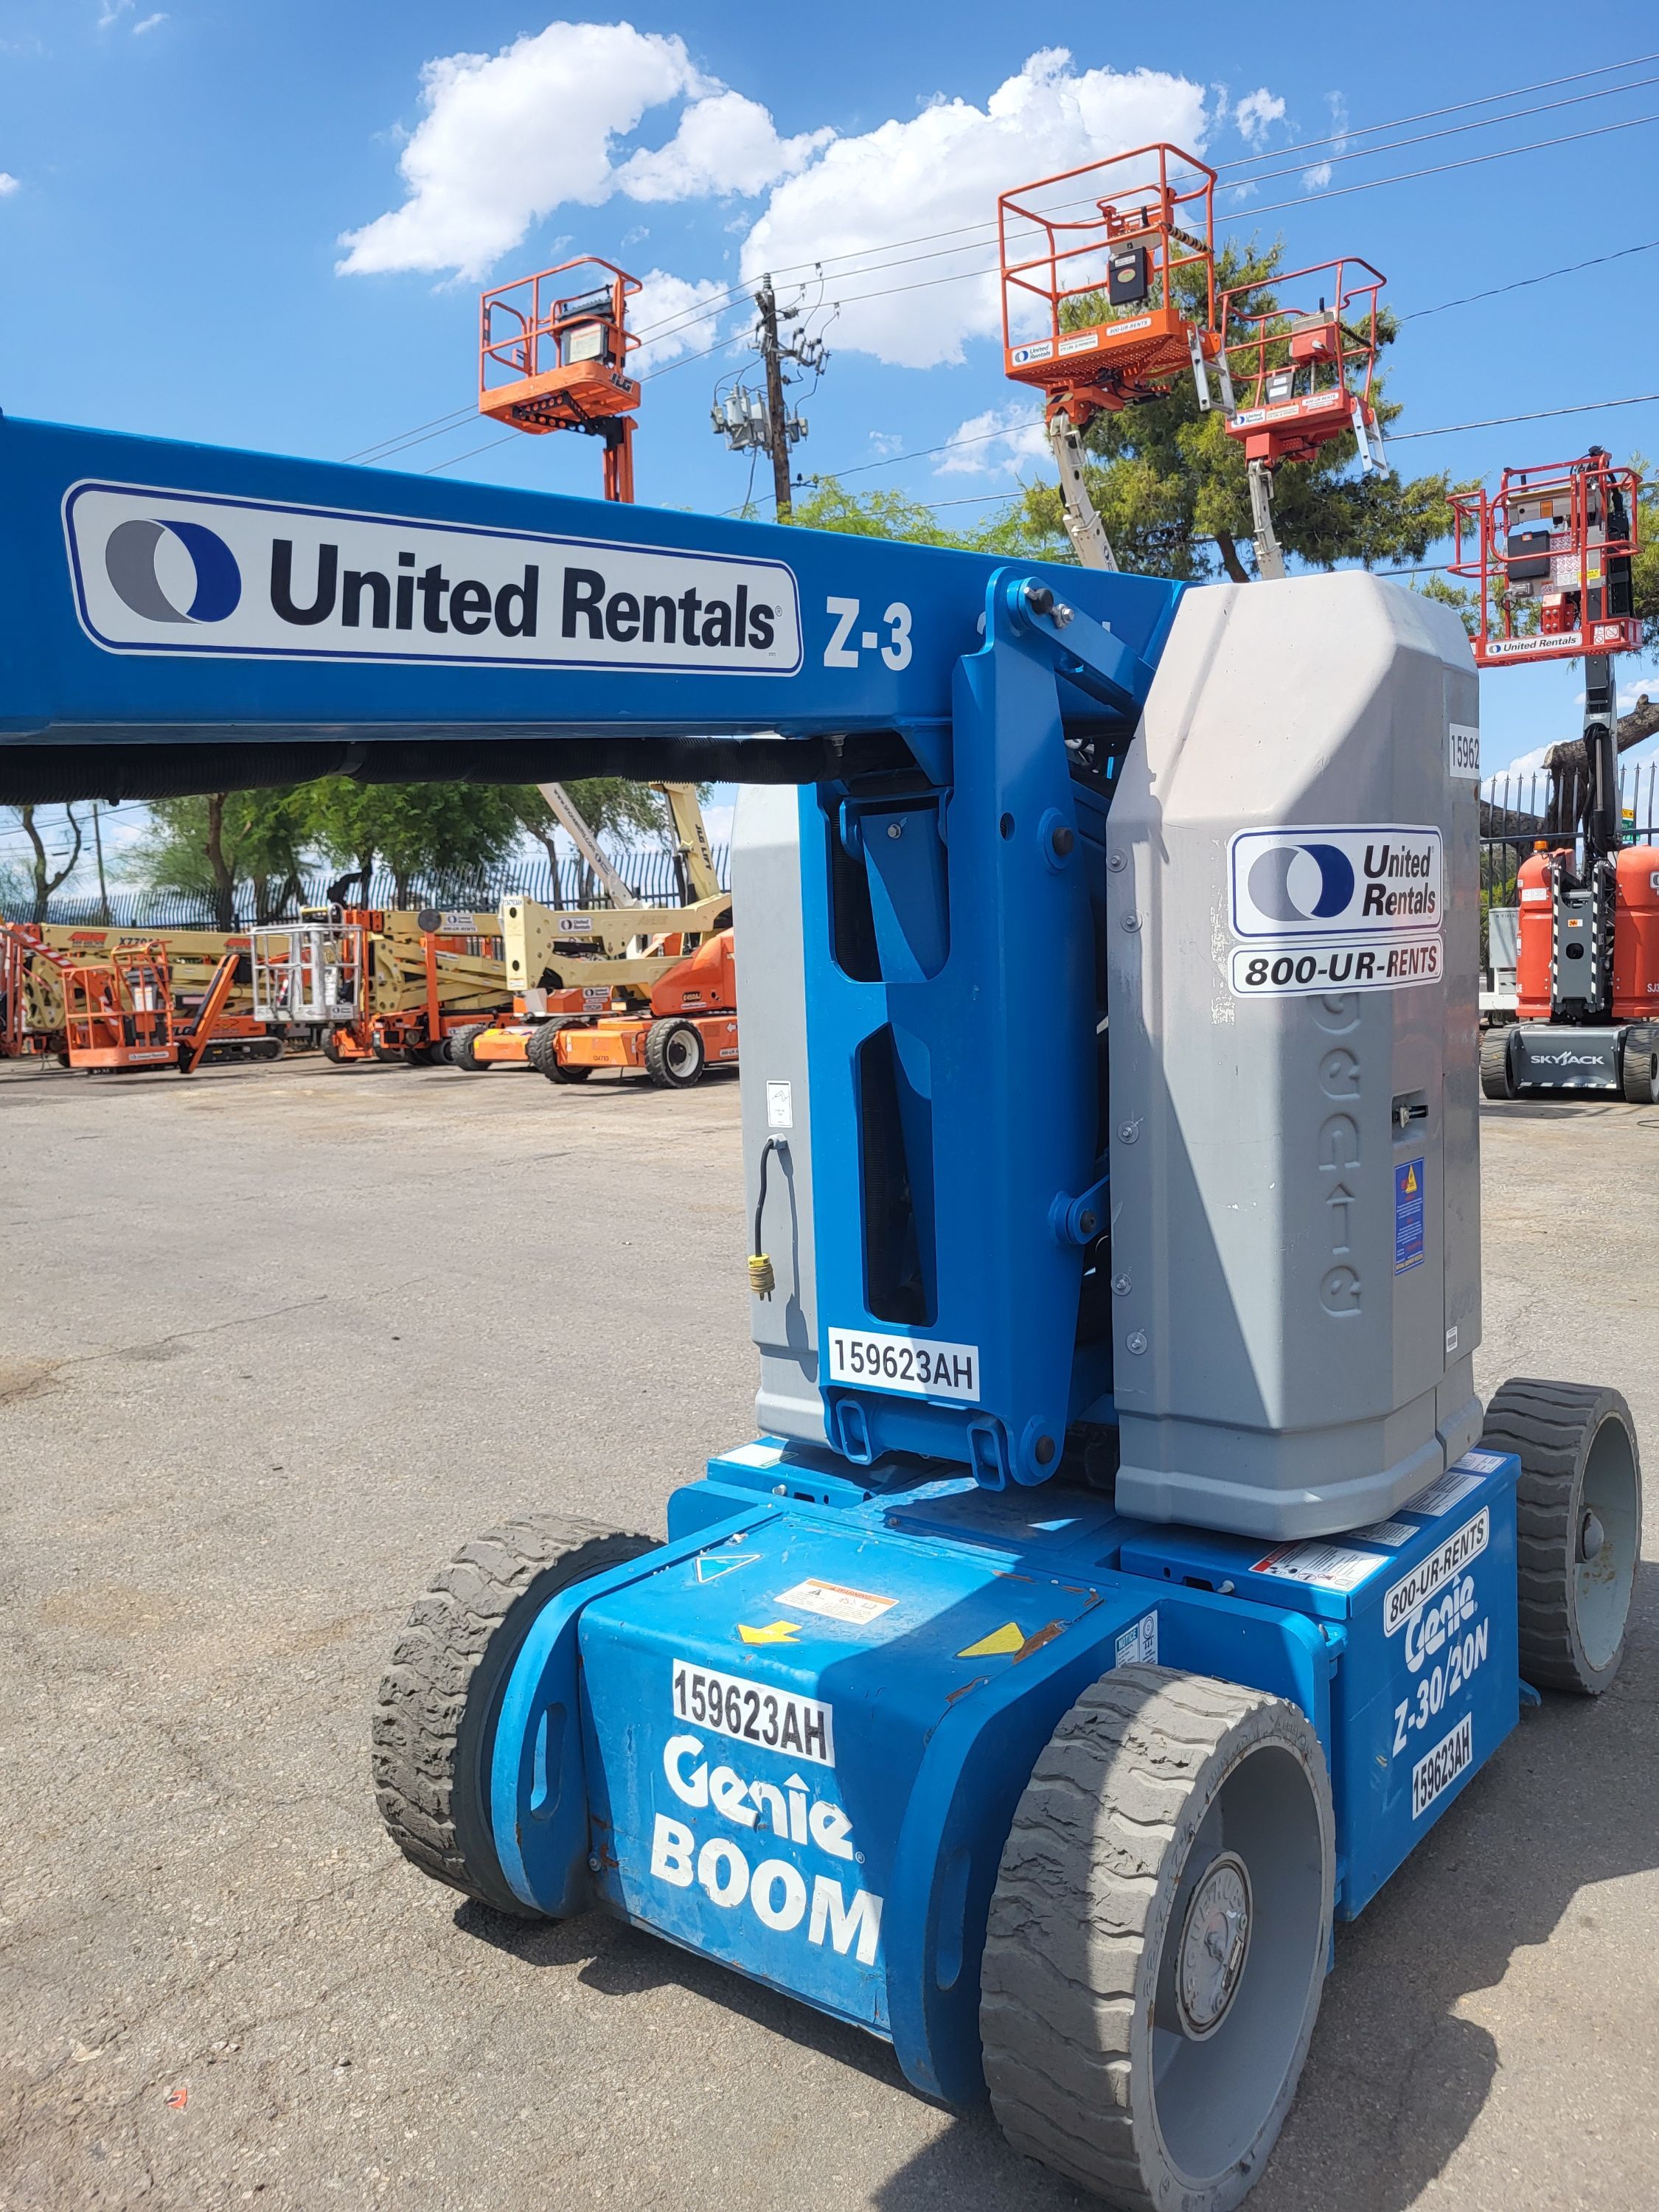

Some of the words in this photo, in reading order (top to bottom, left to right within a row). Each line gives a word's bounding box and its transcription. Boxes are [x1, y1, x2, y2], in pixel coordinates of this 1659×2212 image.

[1029, 344, 1049, 355] United
[1029, 350, 1051, 360] Rentals
[270, 538, 539, 638] United
[561, 566, 775, 650] Rentals
[1503, 640, 1537, 652] United
[1539, 636, 1577, 647] Rentals
[1363, 844, 1431, 879] United
[1362, 882, 1436, 917] Rentals
[1245, 946, 1438, 986] 800-UR-RENTS
[1530, 1051, 1605, 1066] SKYJACK
[834, 1338, 973, 1391] 159623AH
[1389, 1517, 1486, 1623] 800-UR-RENTS
[1118, 1628, 1137, 1651] NOTICE
[1392, 1616, 1489, 1759] Z-30/20N
[674, 1669, 827, 1761] 159623AH
[1413, 1719, 1471, 1815] 159623AH
[663, 1734, 854, 1861] Genie
[650, 1812, 884, 1966] BOOM
